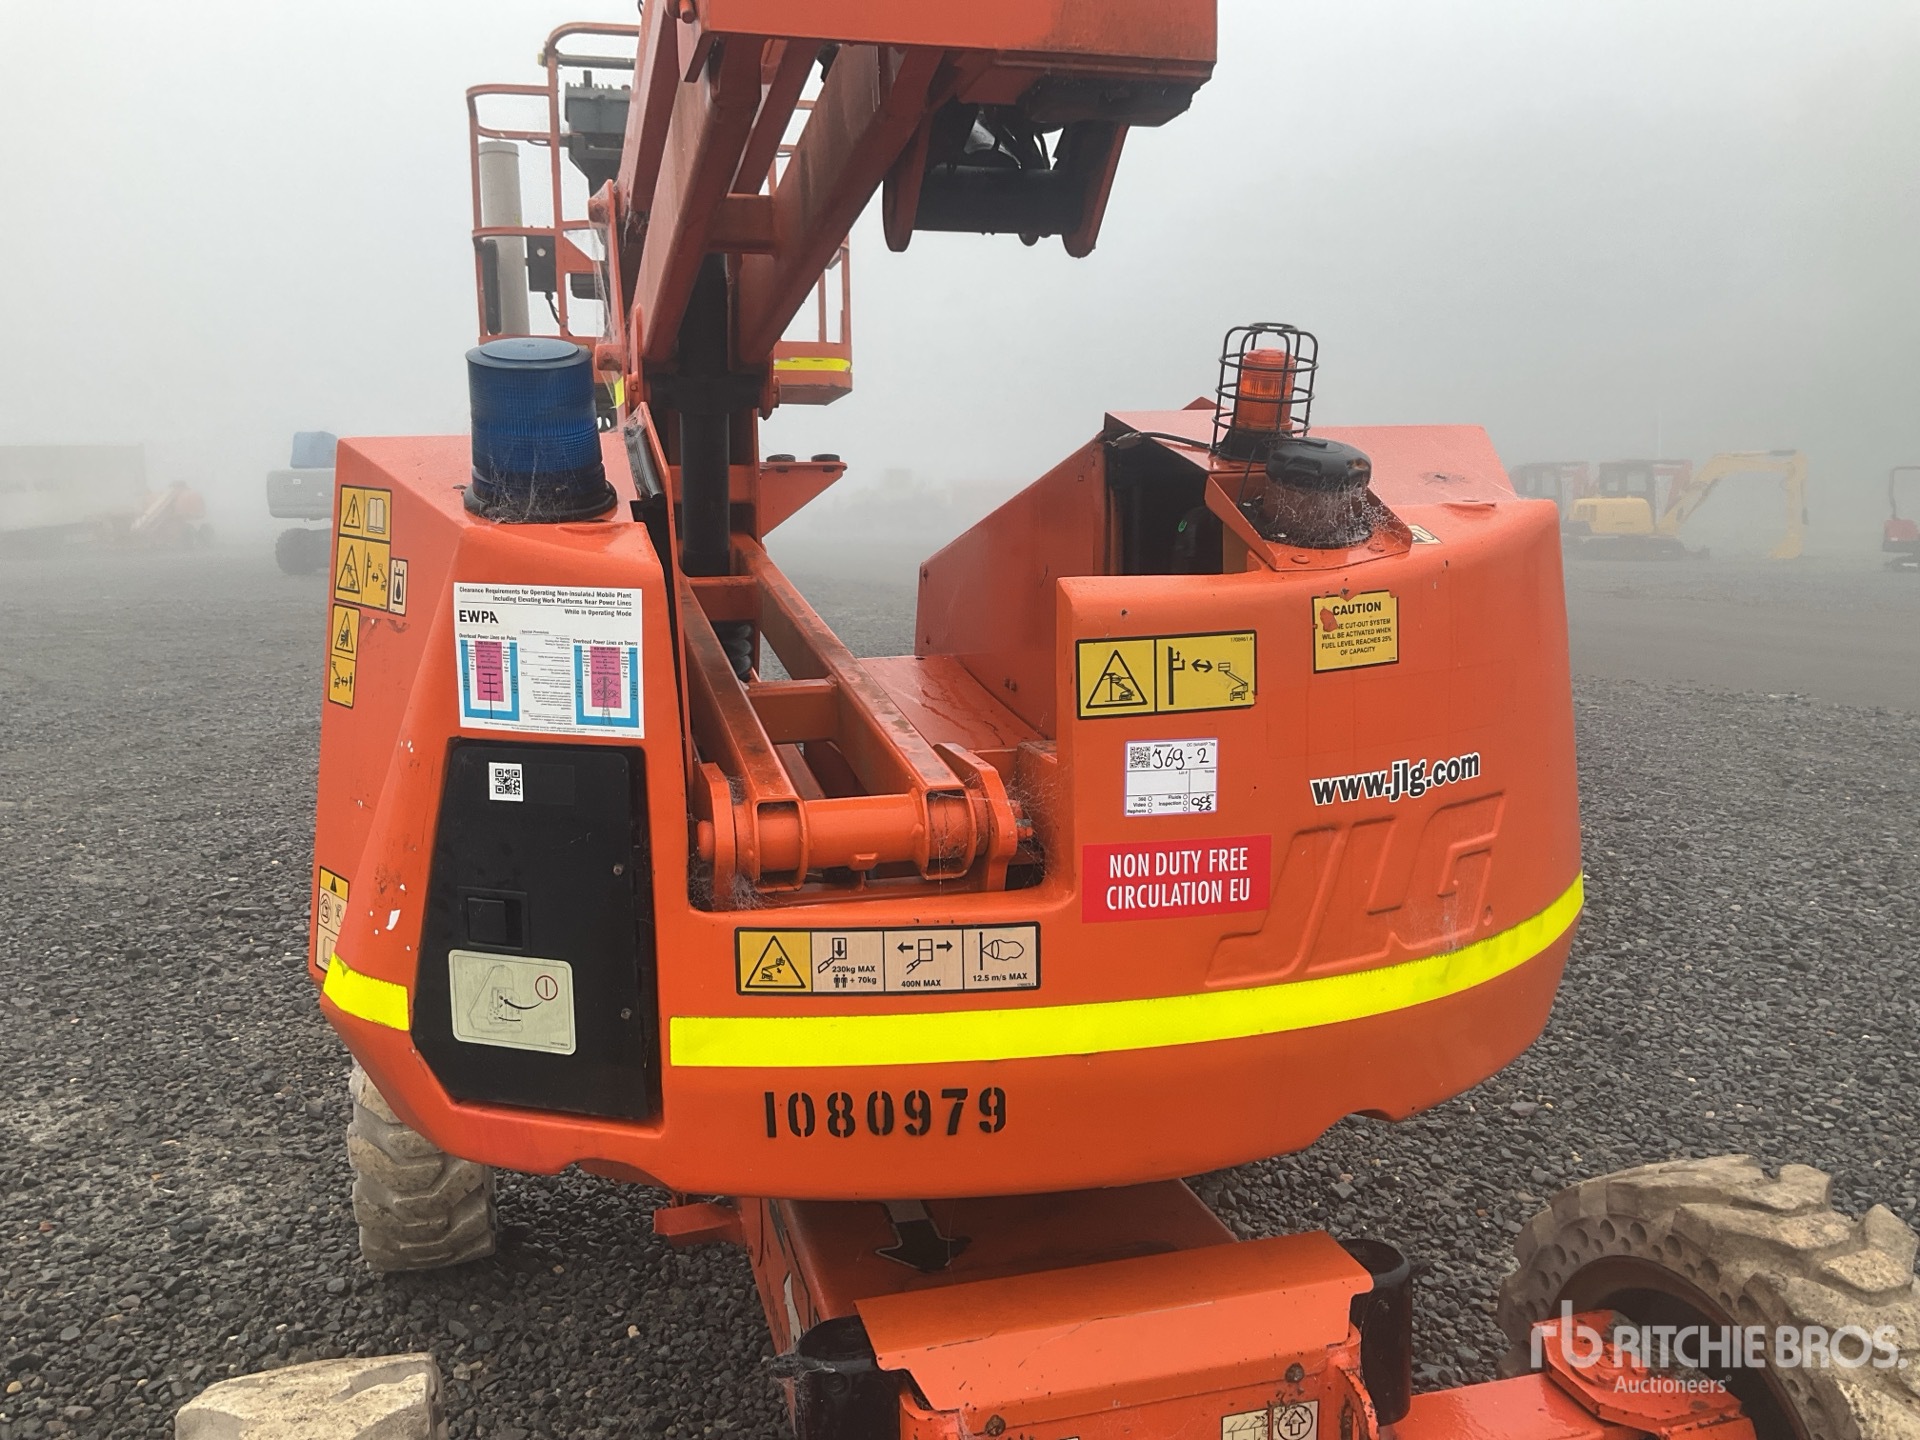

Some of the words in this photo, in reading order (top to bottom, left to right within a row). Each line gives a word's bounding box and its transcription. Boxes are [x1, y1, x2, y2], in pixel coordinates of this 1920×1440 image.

[485, 587, 520, 595] Requirements
[530, 589, 556, 597] Operating
[492, 595, 517, 603] Including
[588, 609, 615, 617] Operating
[1332, 601, 1381, 616] CAUTION
[459, 609, 499, 624] EWPA
[1345, 620, 1368, 629] CUT-OUT
[1370, 618, 1391, 627] SYSTEM
[1346, 628, 1375, 637] ACTIVATED
[1337, 640, 1355, 648] LEVEL
[1356, 636, 1381, 645] REACHES
[1349, 646, 1376, 655] CAPACITY
[1310, 752, 1480, 806] www.jlg.com
[1109, 853, 1150, 879] NON
[1155, 850, 1202, 876] DUTY
[1208, 847, 1248, 873] FREE
[1106, 880, 1223, 910] CIRCULATION
[1229, 878, 1251, 902] EU
[832, 965, 856, 975] 230kg
[858, 965, 876, 973] MAX
[857, 976, 877, 985] 70kg
[973, 974, 990, 982] 12.5
[991, 973, 1007, 981] m/s
[1009, 972, 1028, 980] MAX
[901, 980, 921, 988] 400N
[923, 979, 942, 987] MAX
[764, 1087, 1006, 1138] 1080979
